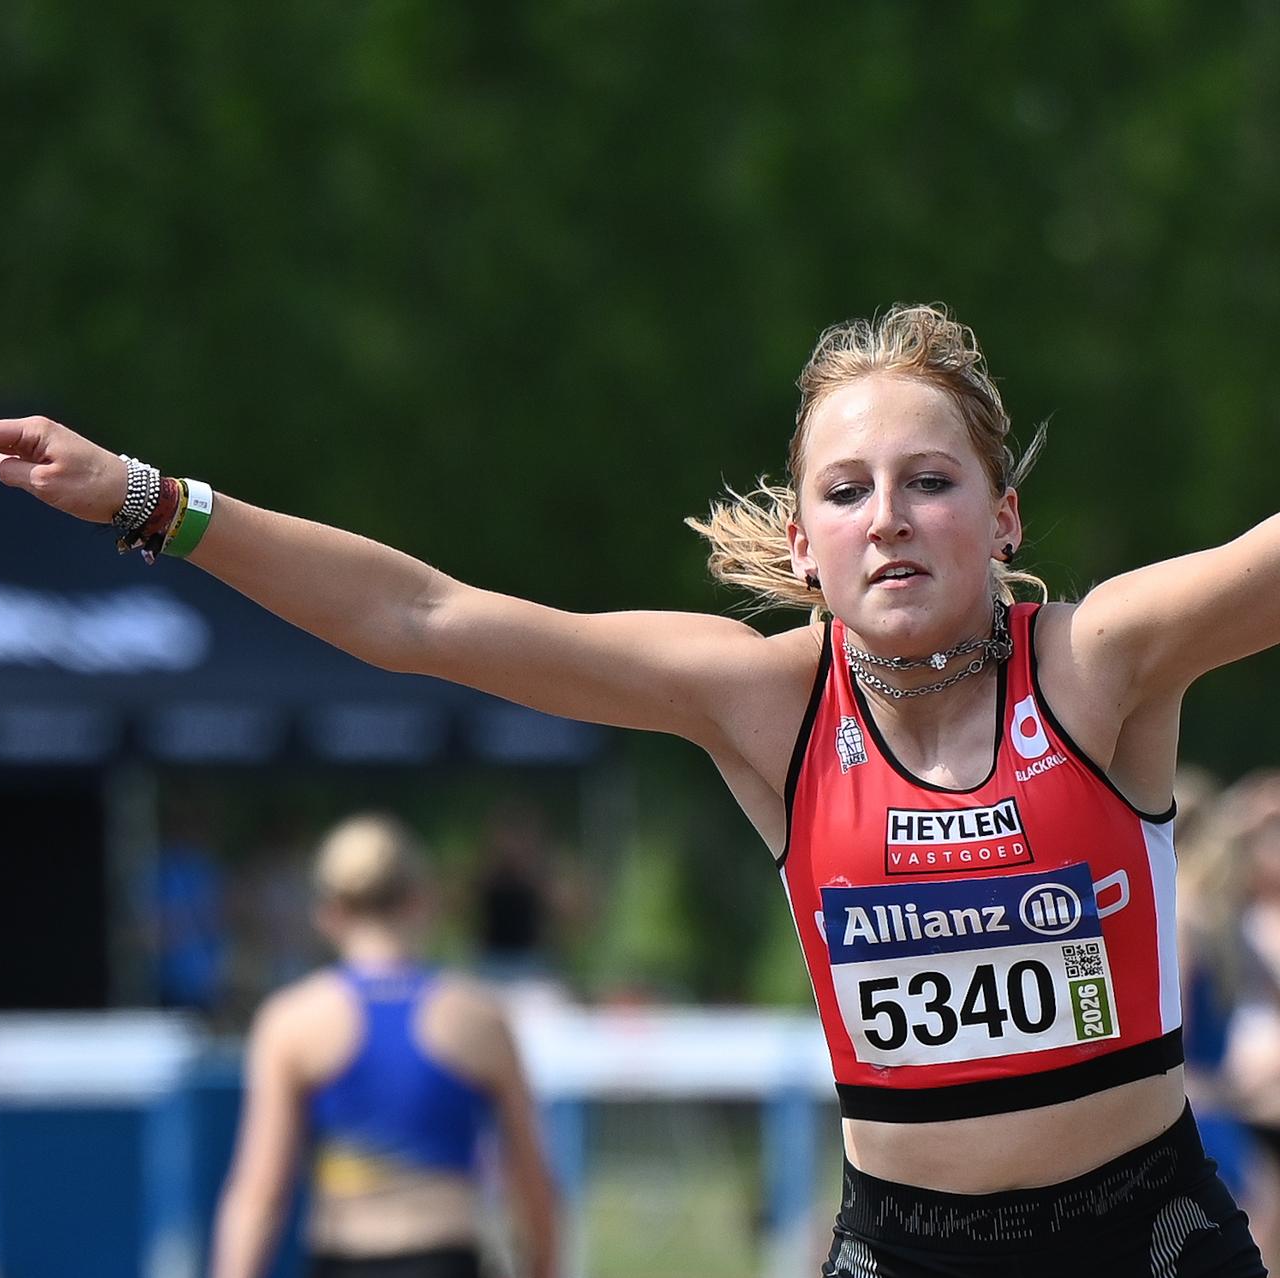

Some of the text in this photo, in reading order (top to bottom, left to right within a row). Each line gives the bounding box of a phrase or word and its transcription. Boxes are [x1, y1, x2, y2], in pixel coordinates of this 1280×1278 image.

[891, 805, 1017, 841] HEYLEN
[891, 843, 1024, 865] VASTGOED
[843, 903, 1010, 946] Allianz
[859, 960, 1057, 1050] 5340
[1078, 983, 1105, 1037] 2026
